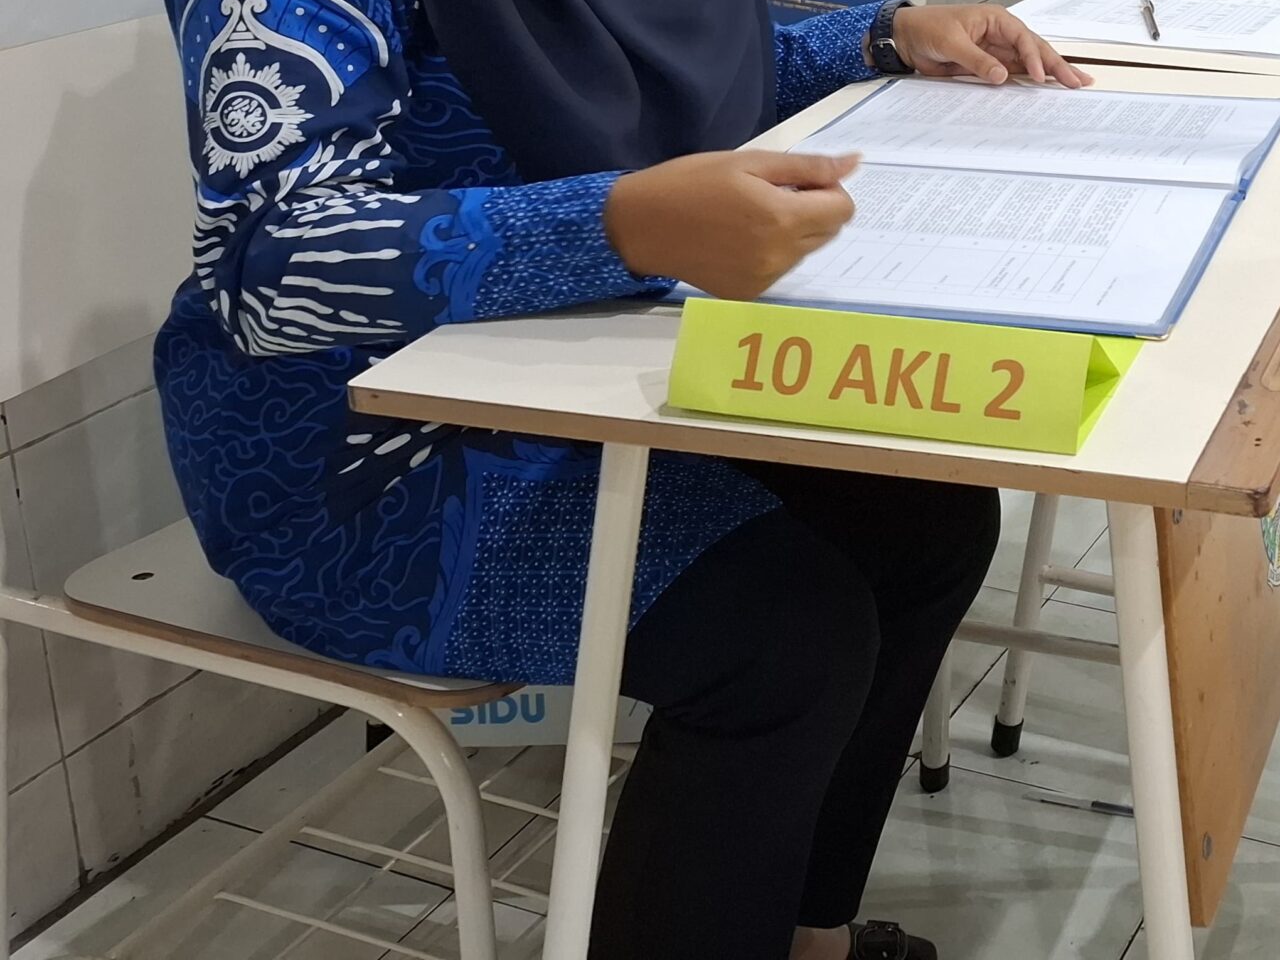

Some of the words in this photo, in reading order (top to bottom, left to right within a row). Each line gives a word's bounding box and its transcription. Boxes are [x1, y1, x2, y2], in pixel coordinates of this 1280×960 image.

[731, 332, 813, 395] 10
[828, 343, 961, 414] AKL
[983, 358, 1025, 421] 2
